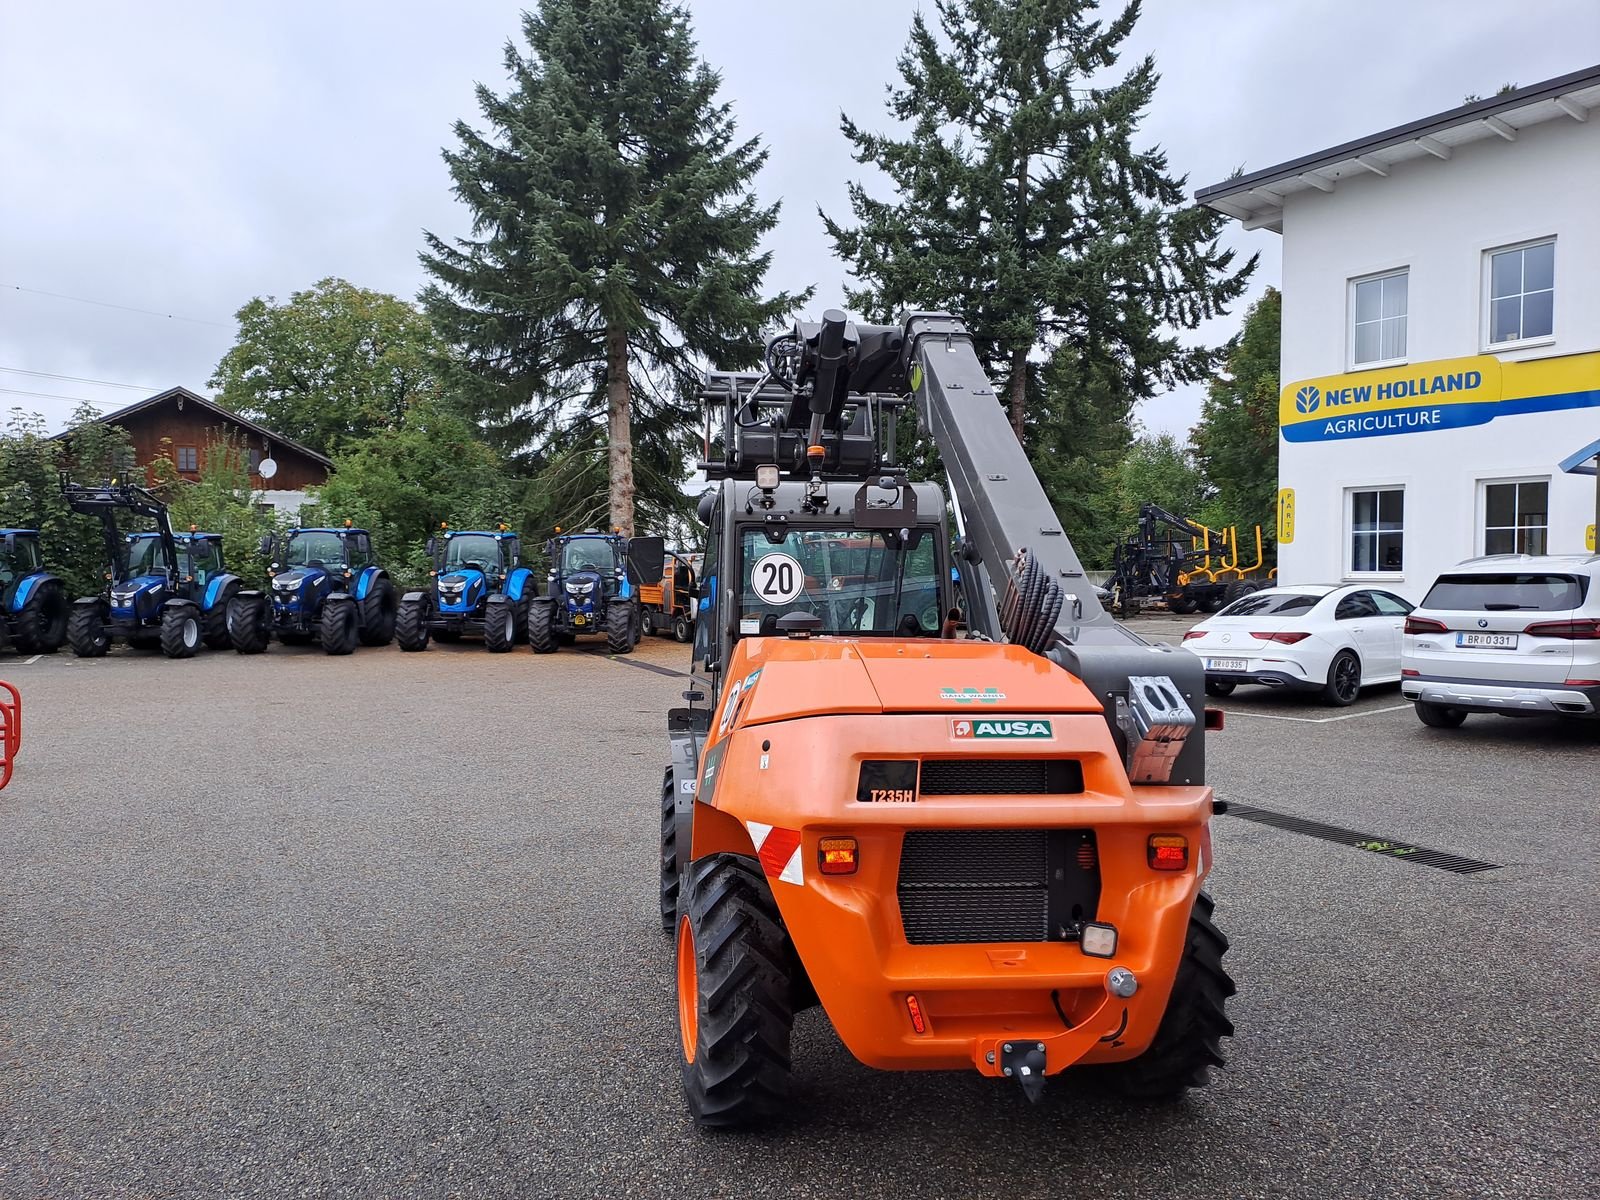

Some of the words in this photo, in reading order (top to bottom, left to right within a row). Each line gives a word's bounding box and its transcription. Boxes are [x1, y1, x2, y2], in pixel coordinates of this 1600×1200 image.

[1325, 385, 1372, 407] NEW
[1377, 371, 1481, 400] HOLLAND
[1324, 409, 1441, 435] AGRICULTURE
[762, 562, 794, 595] 20
[1467, 635, 1480, 644] BR
[976, 721, 1050, 736] AUSA
[870, 789, 914, 803] T235H
